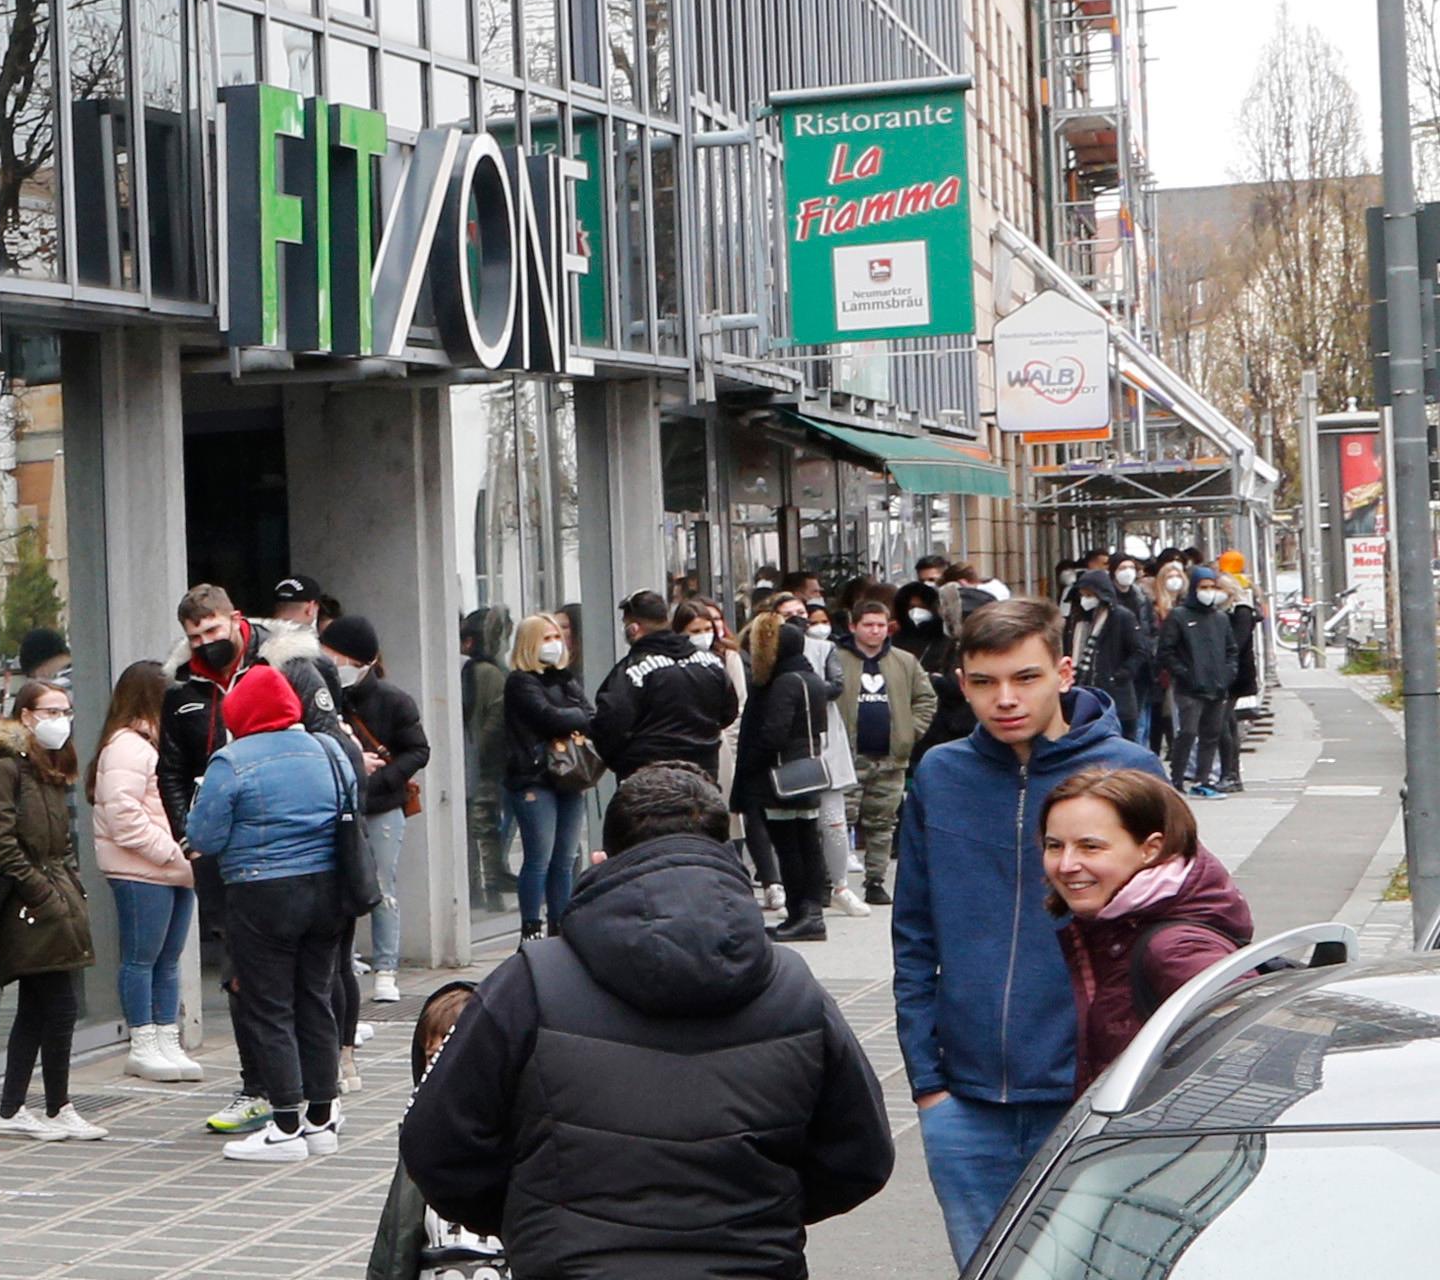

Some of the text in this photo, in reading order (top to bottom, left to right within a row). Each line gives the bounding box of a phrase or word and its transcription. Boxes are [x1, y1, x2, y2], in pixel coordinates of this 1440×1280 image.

[794, 105, 953, 137] Ristorante
[828, 143, 883, 185] La
[796, 175, 961, 242] Fiamma
[841, 296, 924, 314] Lammsbräu
[1007, 368, 1075, 388] WALB
